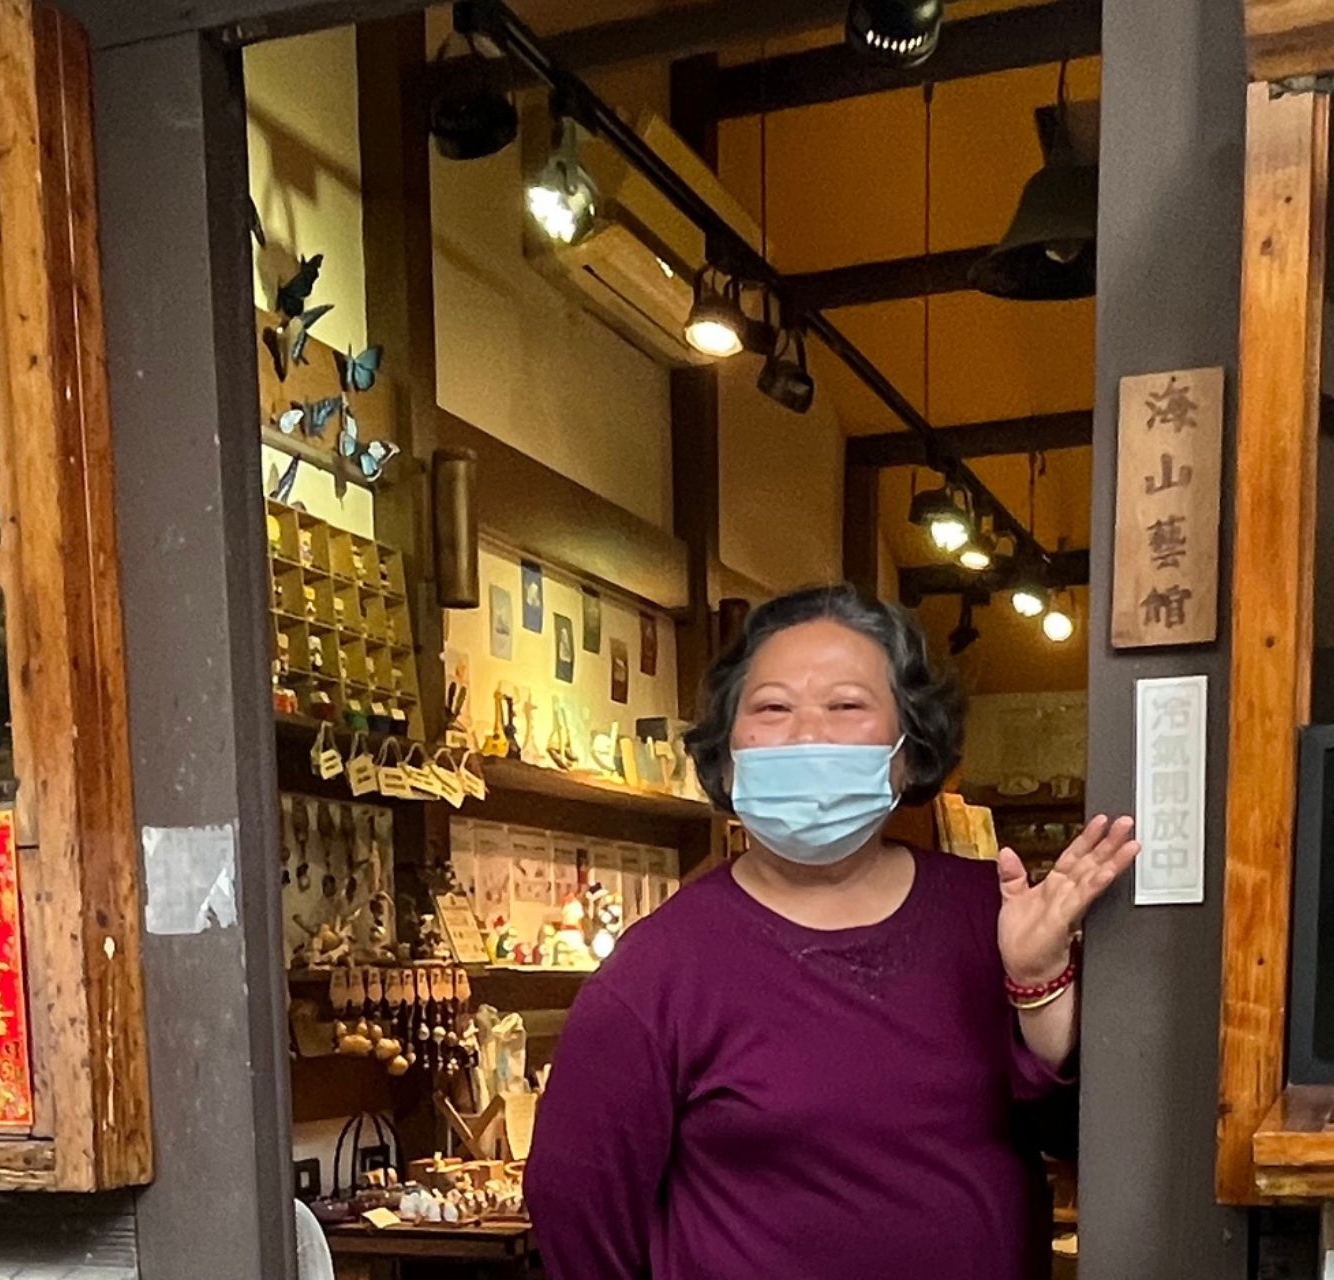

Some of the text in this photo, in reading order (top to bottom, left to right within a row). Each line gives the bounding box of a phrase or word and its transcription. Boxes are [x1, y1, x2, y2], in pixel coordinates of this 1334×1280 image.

[1140, 383, 1198, 628] 海山藝館
[1150, 694, 1191, 877] 冷氣開放中
